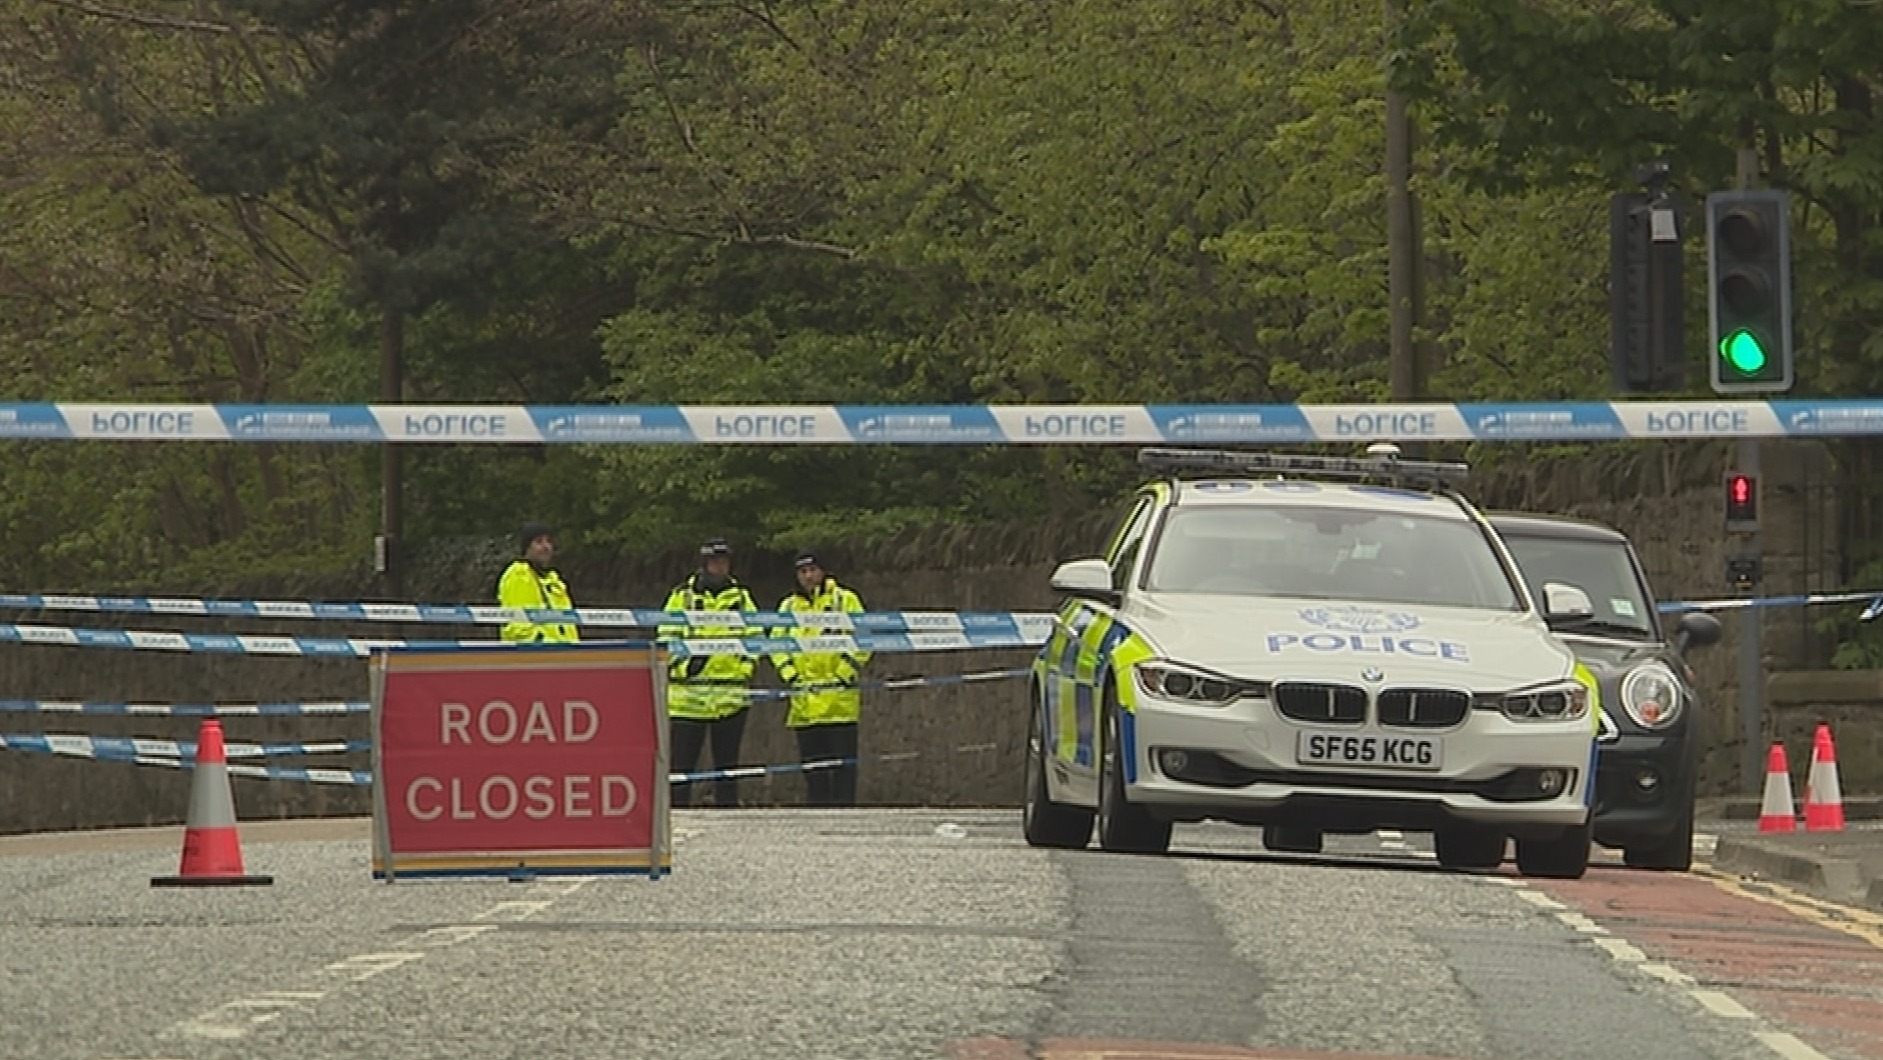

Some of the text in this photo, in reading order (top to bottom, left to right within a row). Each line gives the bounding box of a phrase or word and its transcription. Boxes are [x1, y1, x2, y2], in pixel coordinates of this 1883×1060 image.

[1266, 634, 1470, 663] POLICE
[441, 700, 600, 745] ROAD
[1309, 734, 1433, 765] SF65 KCG
[405, 774, 638, 821] CLOSED
